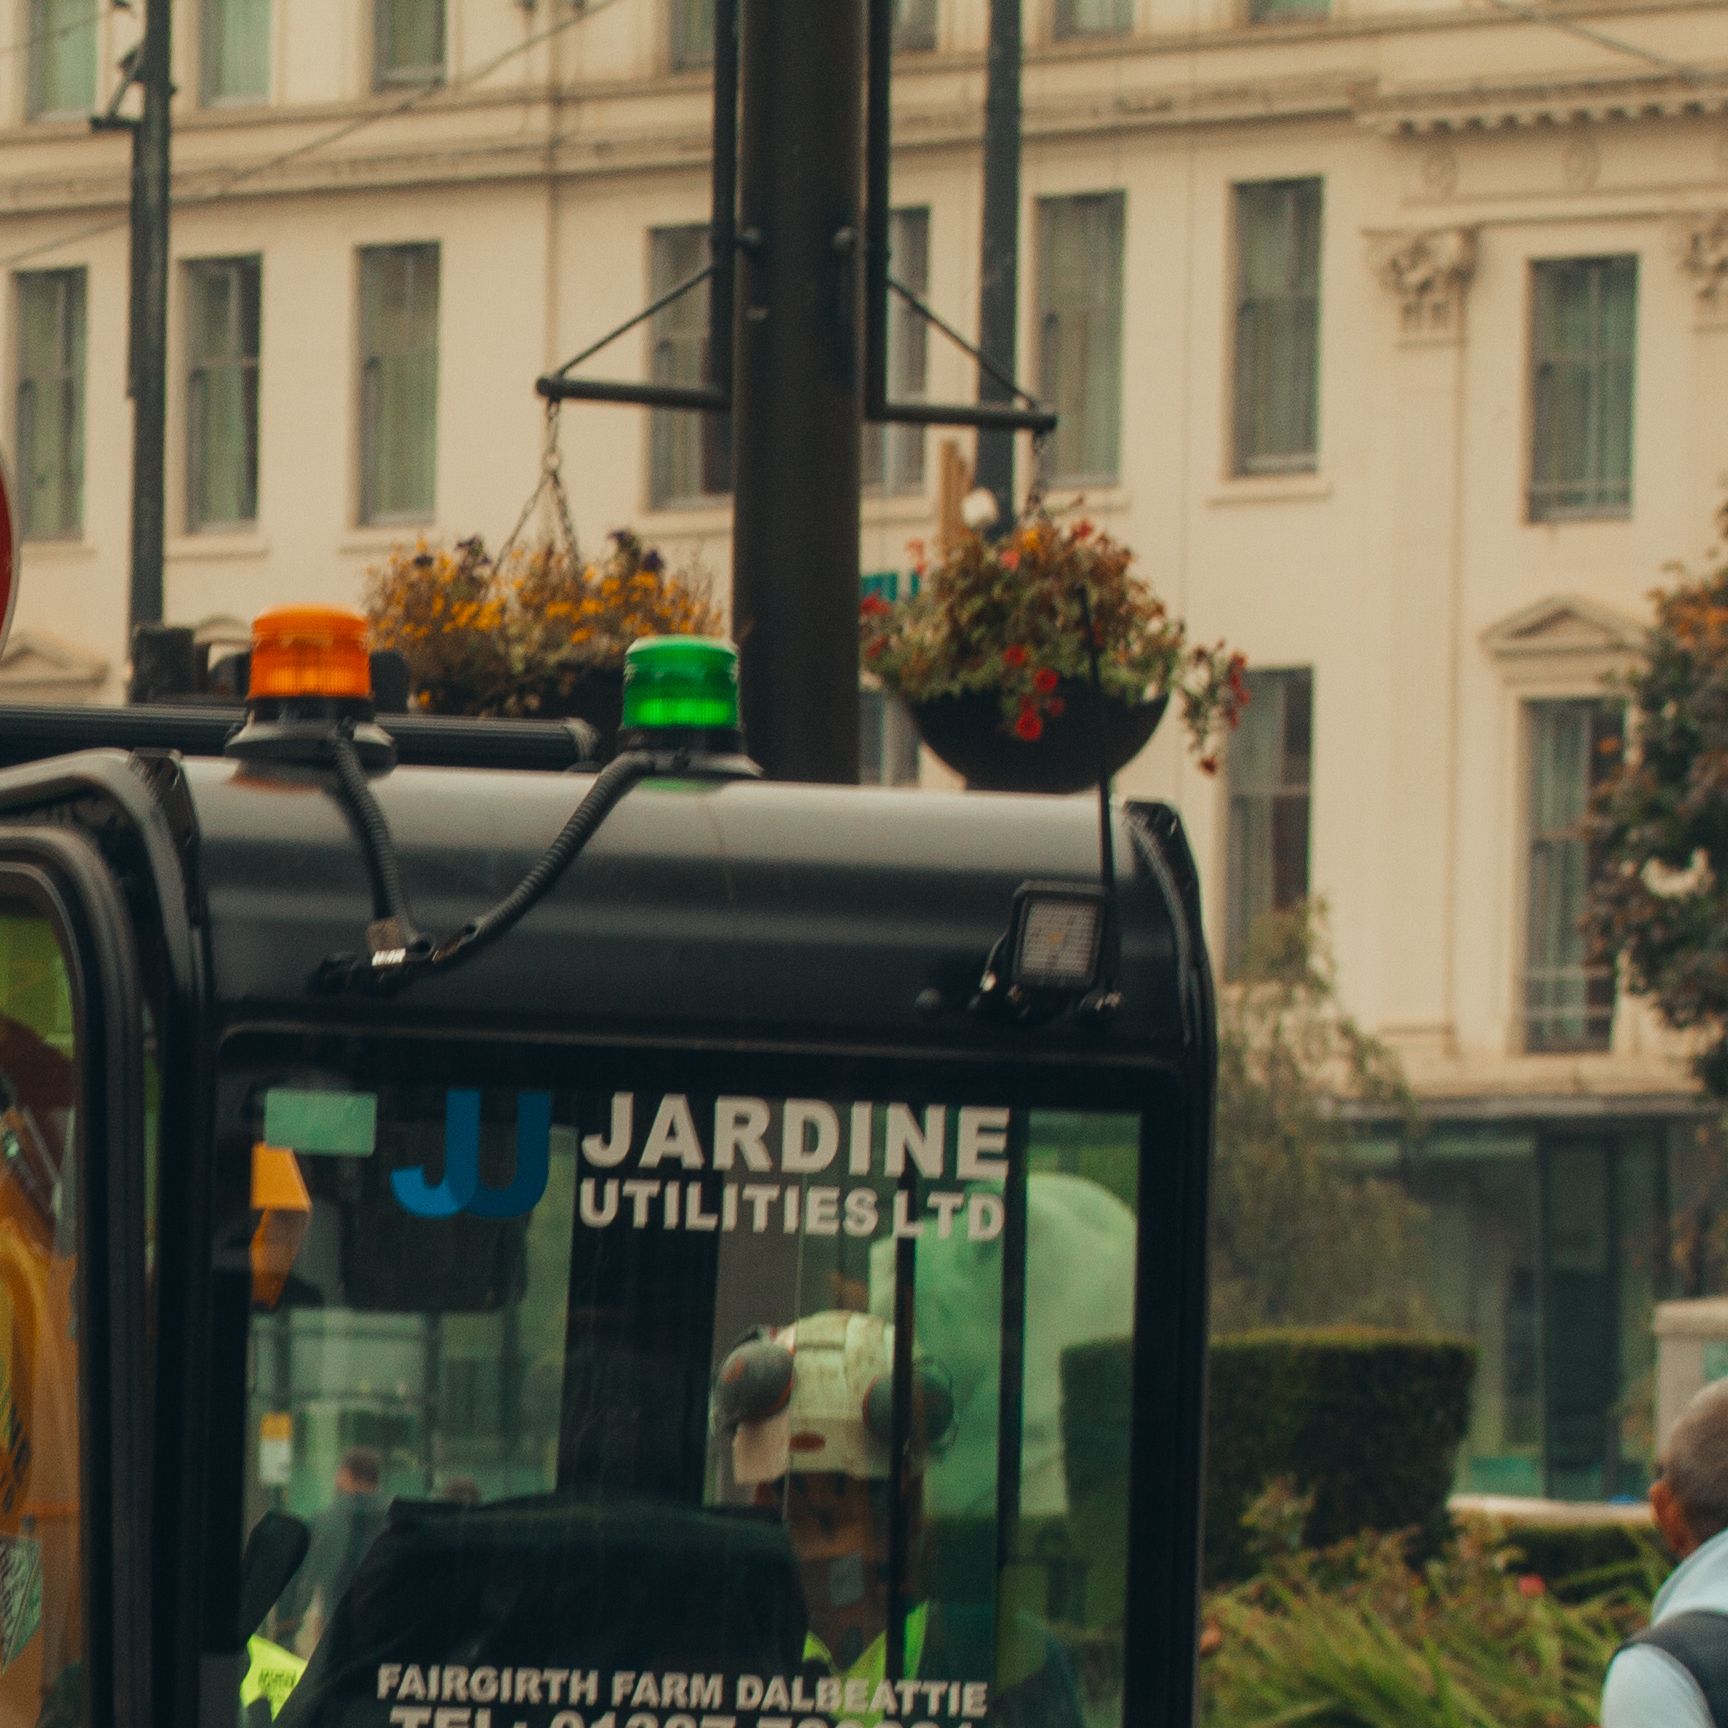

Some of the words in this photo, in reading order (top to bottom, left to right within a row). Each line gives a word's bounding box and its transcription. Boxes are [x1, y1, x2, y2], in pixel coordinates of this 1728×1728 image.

[581, 1091, 1011, 1180] JARDINE
[579, 1178, 880, 1237] UTILITIES
[893, 1190, 1005, 1240] LTD
[376, 1663, 599, 1706] FAIRGIRTH
[611, 1670, 723, 1711] FARM
[735, 1673, 989, 1718] DALBEATTIE
